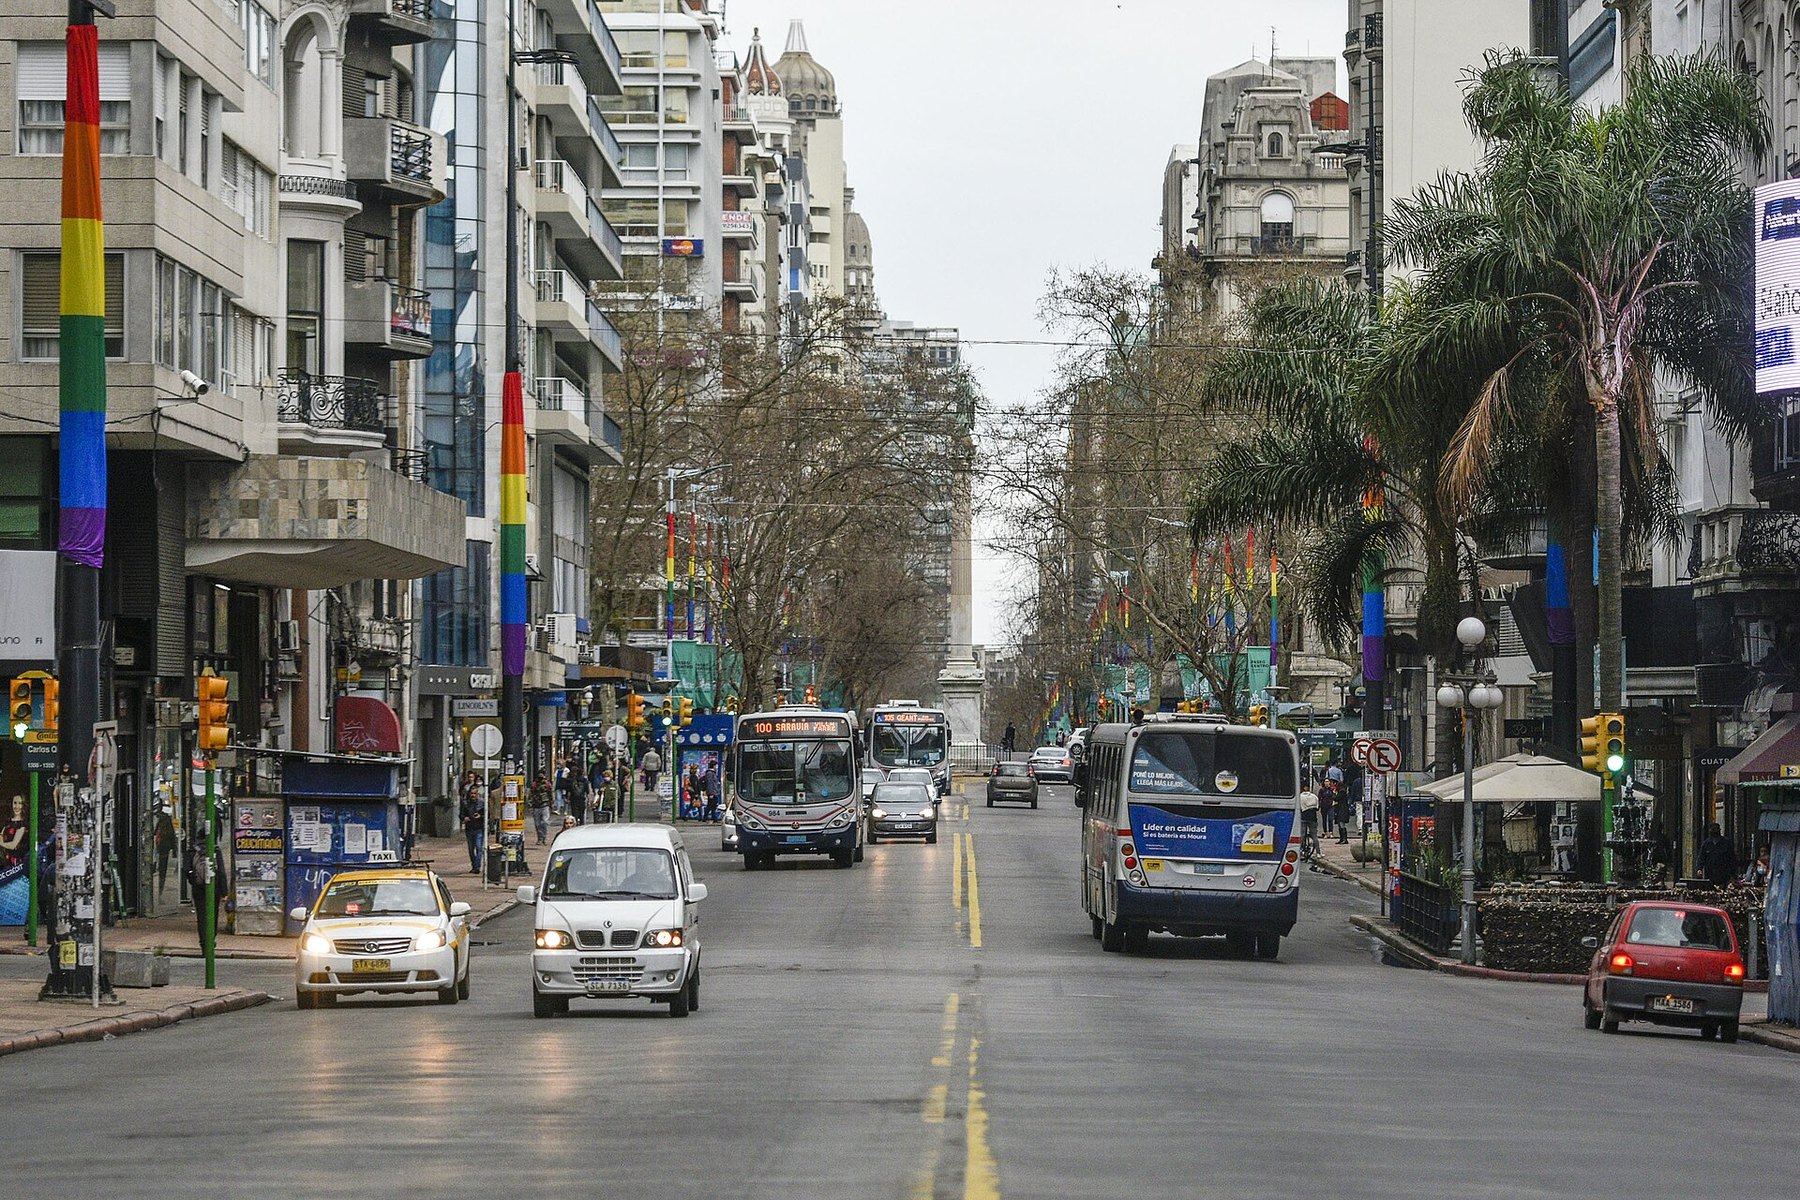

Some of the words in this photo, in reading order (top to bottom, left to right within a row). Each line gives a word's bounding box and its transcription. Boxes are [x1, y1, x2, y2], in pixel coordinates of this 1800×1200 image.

[755, 722, 773, 733] 100
[775, 722, 810, 732] SARAVIA
[27, 745, 50, 753] Carlos
[1142, 823, 1164, 831] Líder
[1176, 825, 1207, 833] calidad
